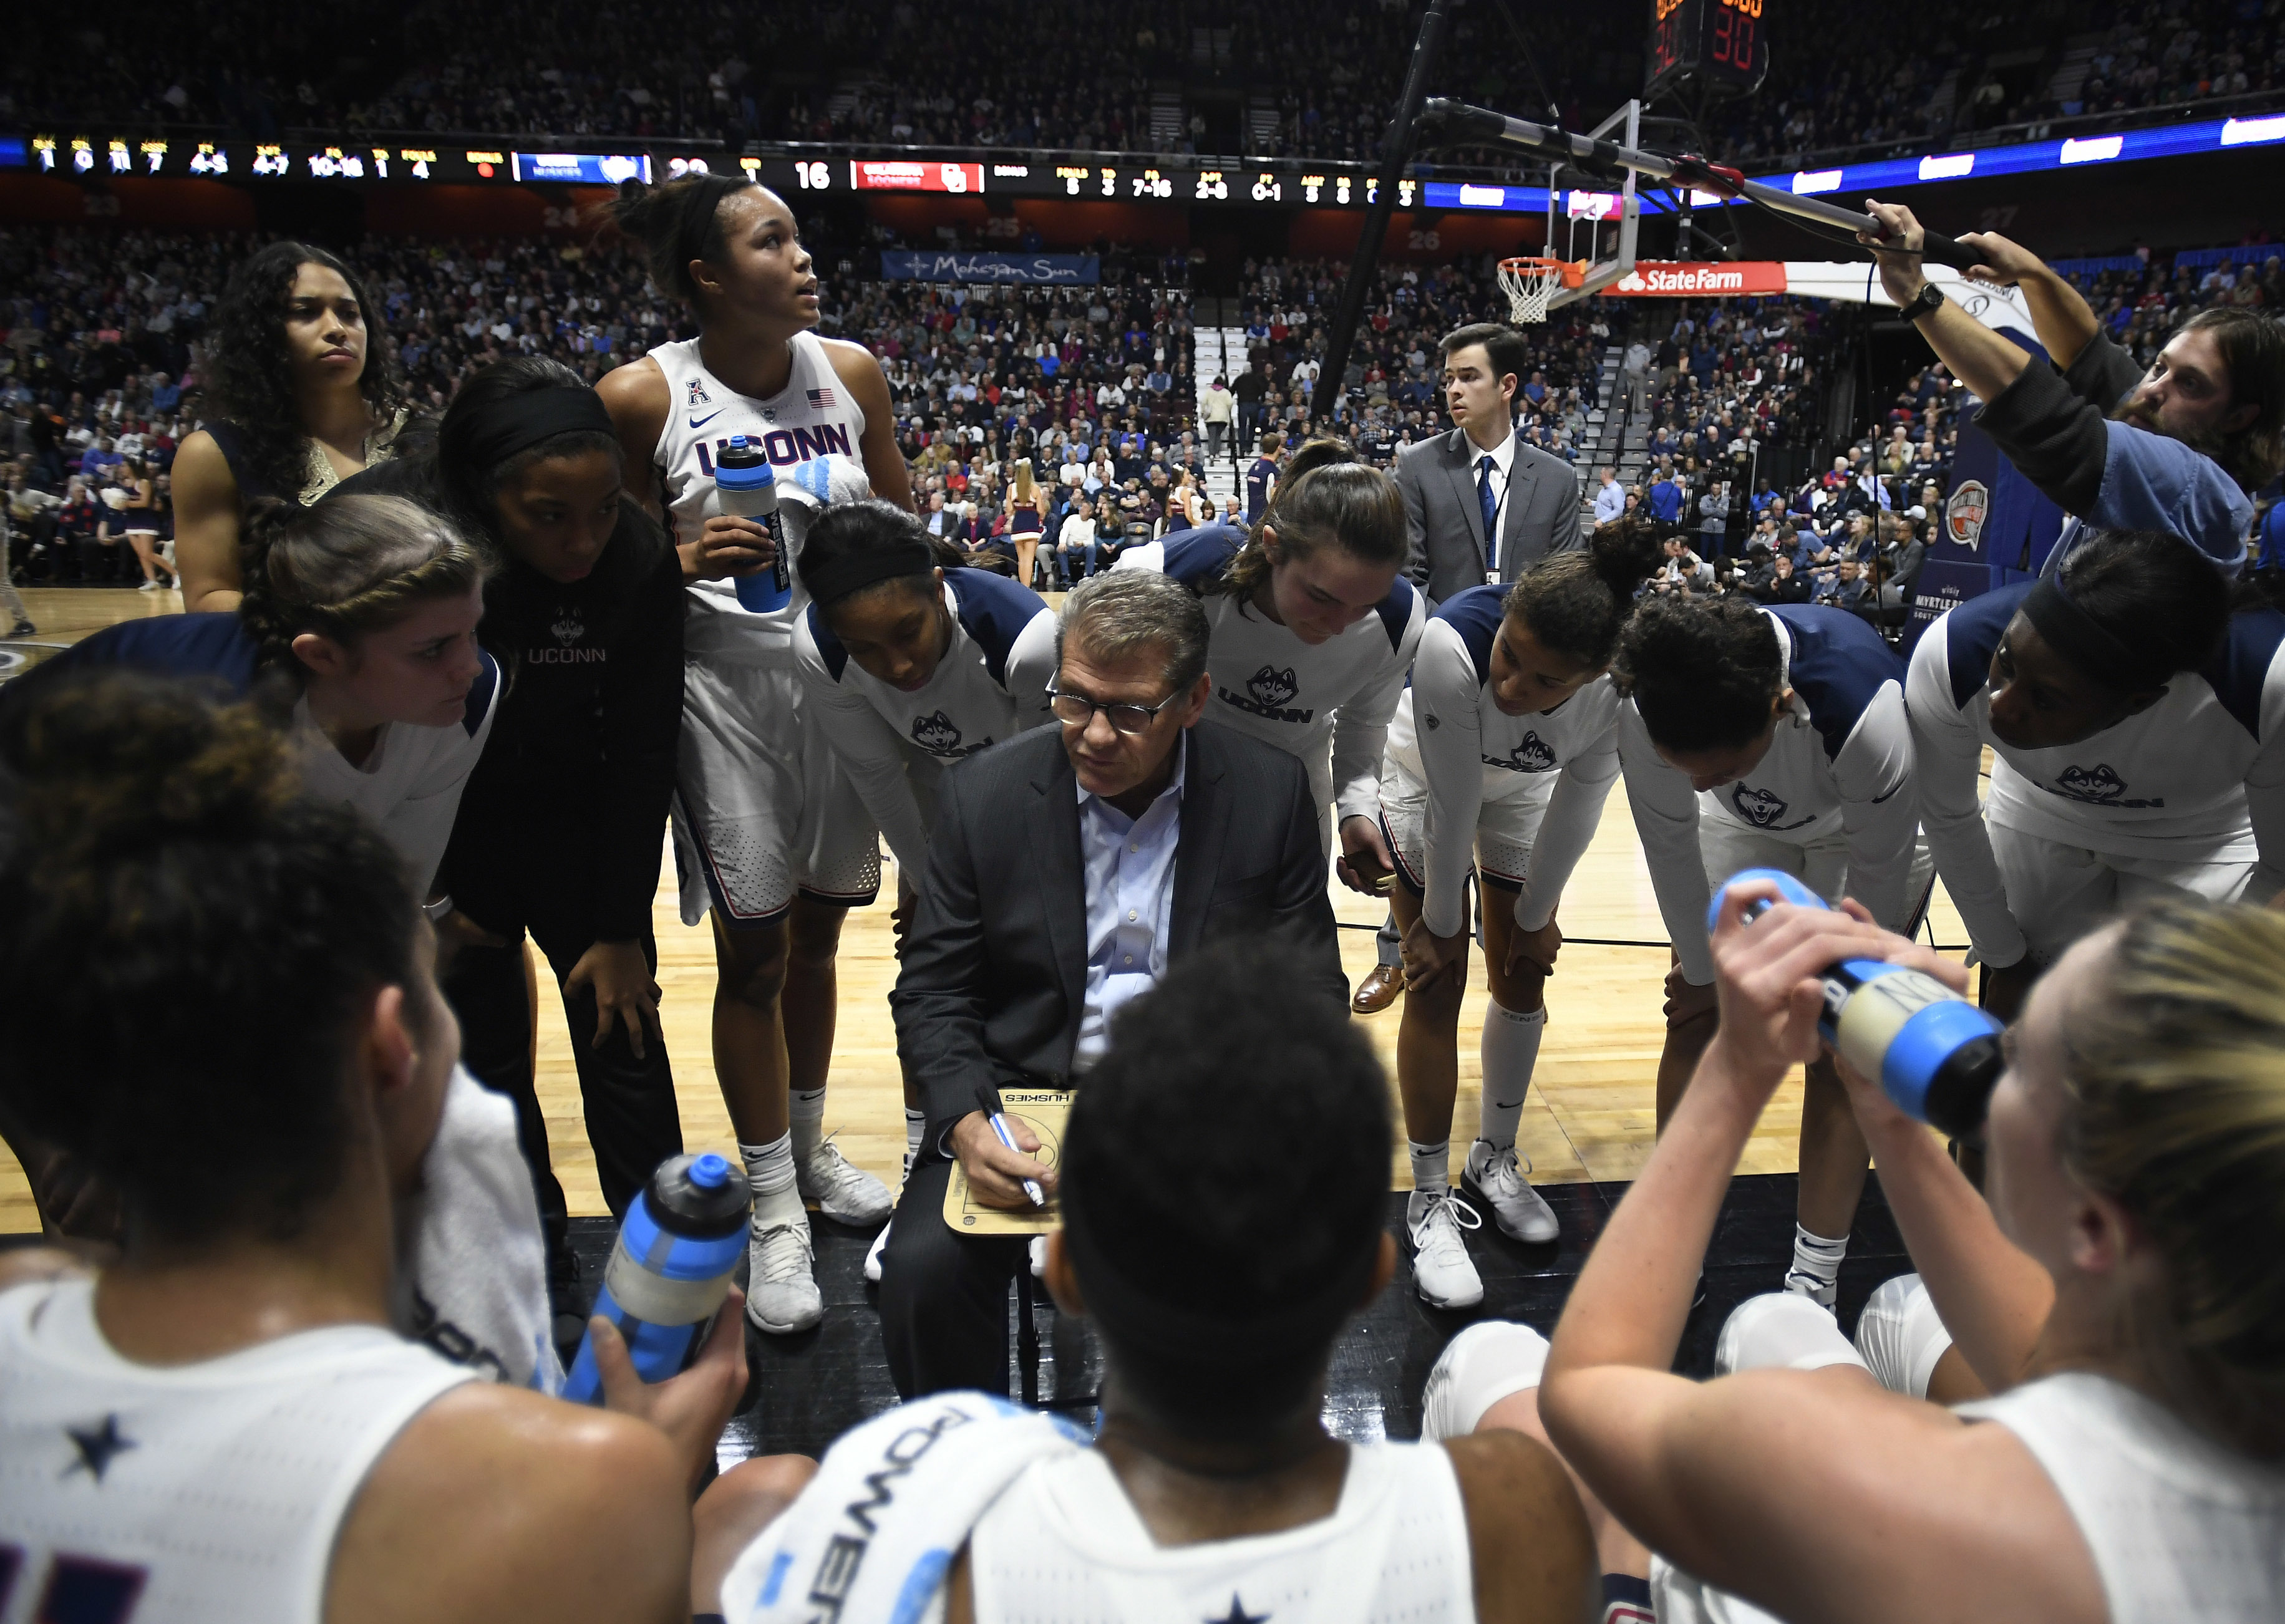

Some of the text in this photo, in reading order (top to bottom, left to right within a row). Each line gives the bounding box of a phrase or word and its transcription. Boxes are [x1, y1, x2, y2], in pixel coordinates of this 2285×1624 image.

[1714, 5, 1755, 70] 30
[795, 162, 830, 188] 16
[1252, 183, 1281, 201] 0-1
[544, 207, 578, 227] 24
[1981, 206, 2017, 228] 27
[987, 218, 1019, 237] 25
[1409, 231, 1440, 250] 26
[933, 256, 1079, 279] Mohegan Sun
[1915, 594, 1951, 611] MYRTLE
[529, 648, 606, 664] UCONN
[1218, 686, 1314, 724] UCONN
[1004, 1094, 1069, 1103] HUSKIES
